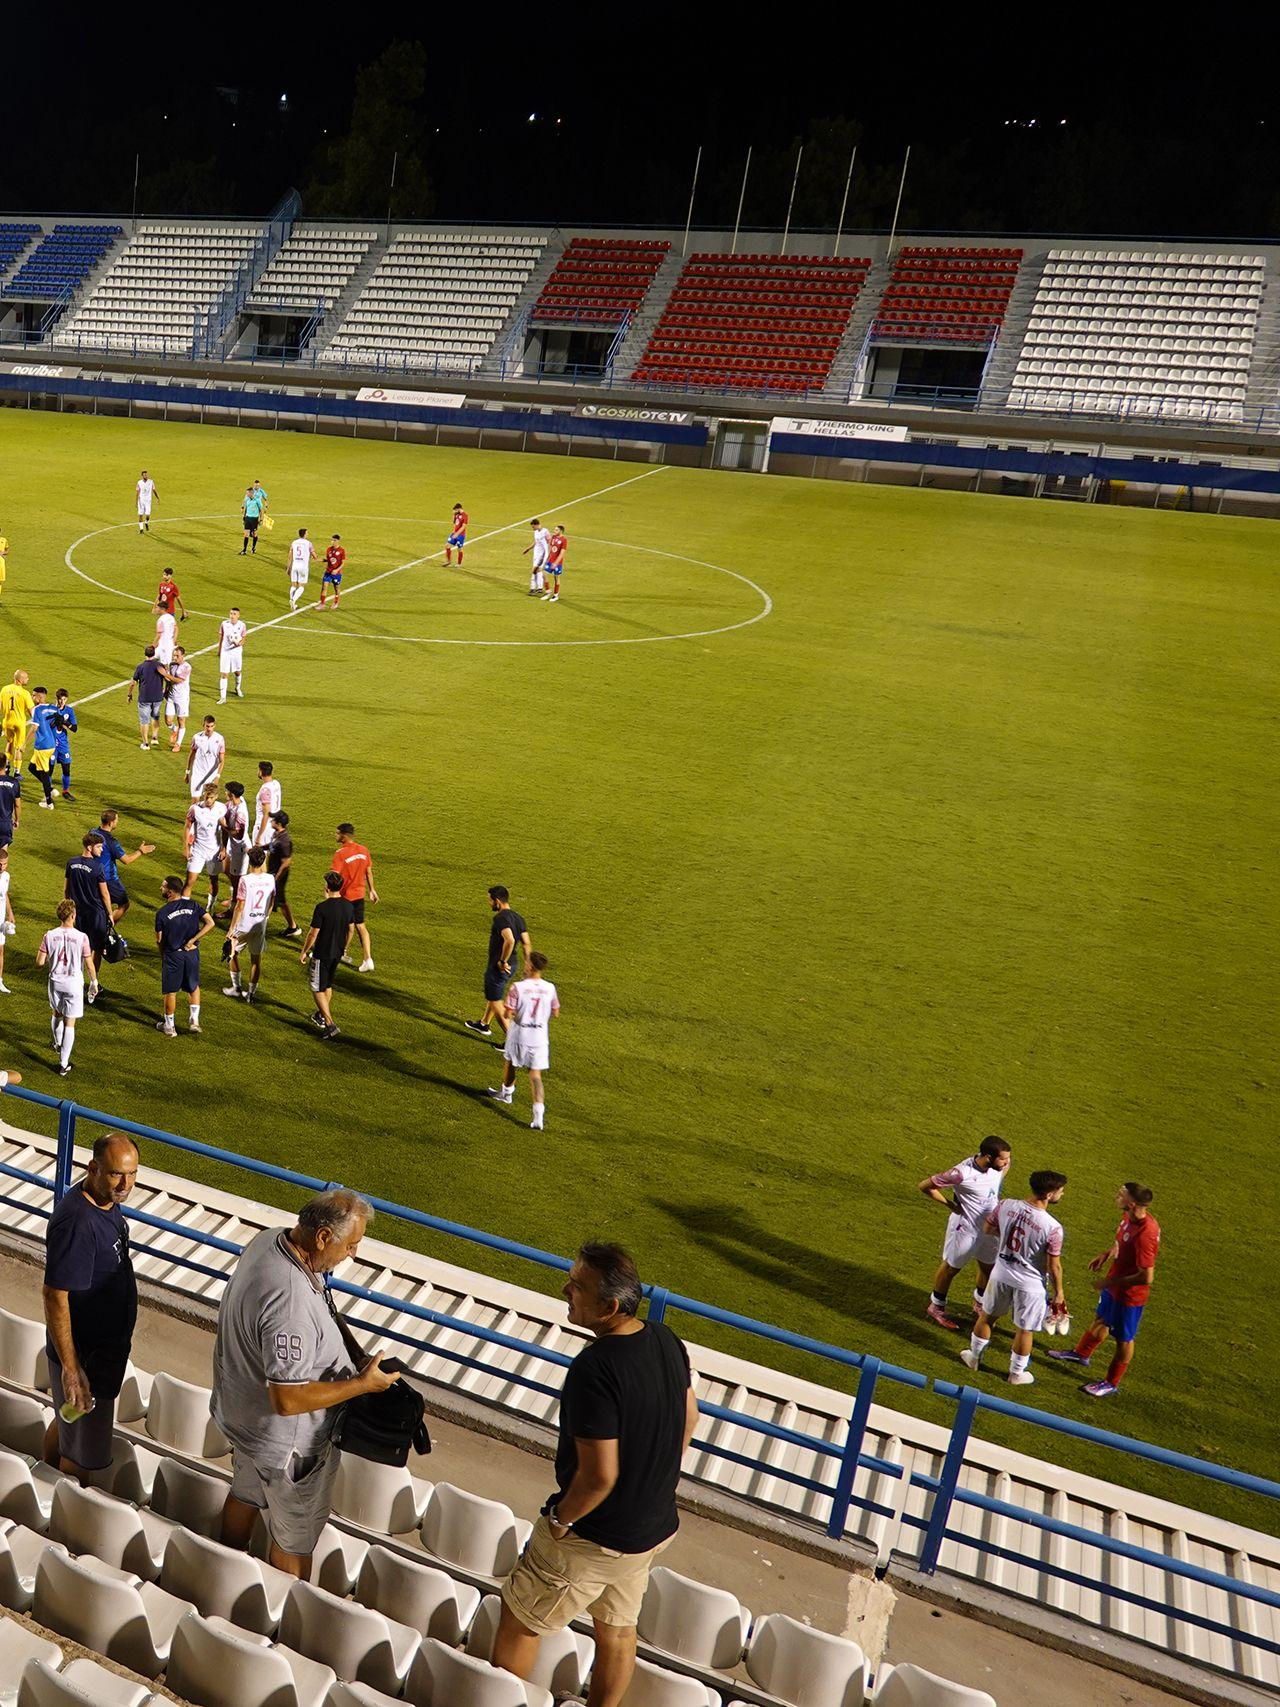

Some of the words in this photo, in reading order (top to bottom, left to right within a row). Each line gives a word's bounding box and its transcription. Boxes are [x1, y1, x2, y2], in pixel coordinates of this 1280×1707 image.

[11, 364, 64, 377] novibet
[813, 428, 856, 437] HELLAS
[816, 420, 865, 430] THERMO
[866, 425, 895, 433] KING
[253, 890, 265, 909] 2
[57, 946, 68, 967] 4
[531, 997, 541, 1018] 7
[1006, 1226, 1026, 1253] 6
[275, 1333, 303, 1361] 99
